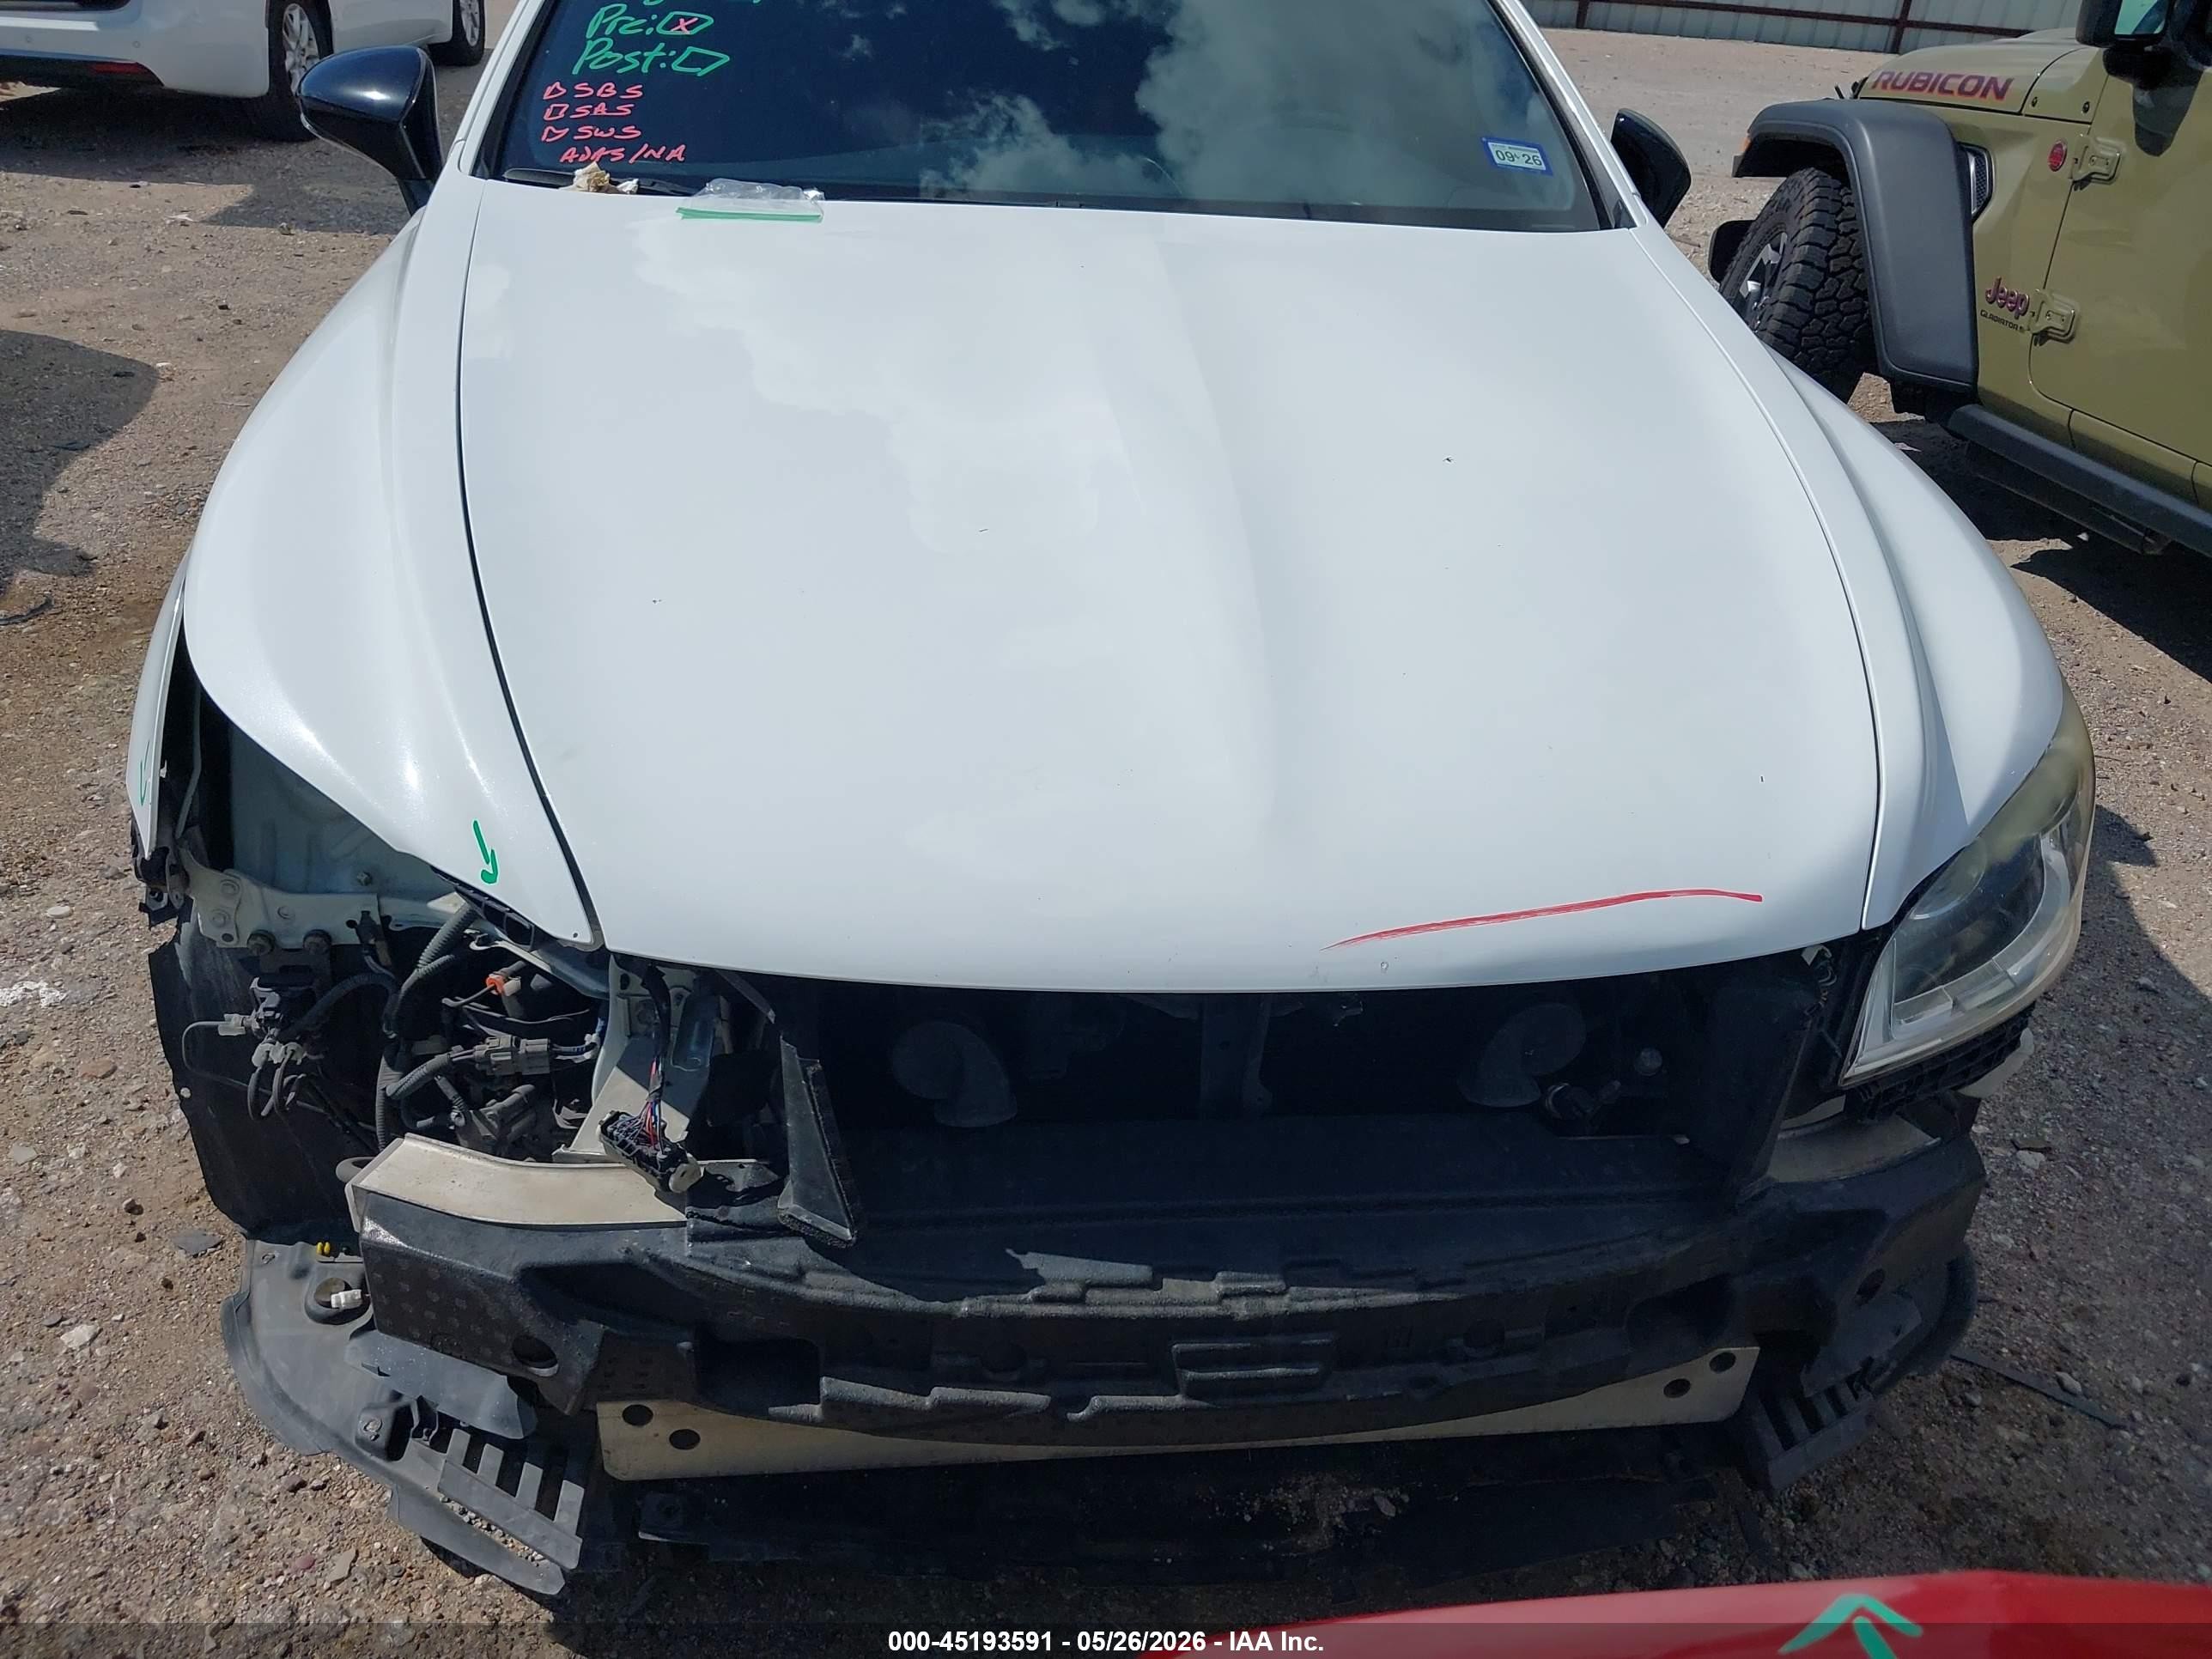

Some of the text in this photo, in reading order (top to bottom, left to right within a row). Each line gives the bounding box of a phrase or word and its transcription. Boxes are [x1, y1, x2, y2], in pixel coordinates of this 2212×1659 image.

[572, 37, 678, 75] Post:
[1872, 70, 2015, 101] RUBICON
[1495, 149, 1542, 166] 09 26
[1985, 276, 2030, 320] Jeep
